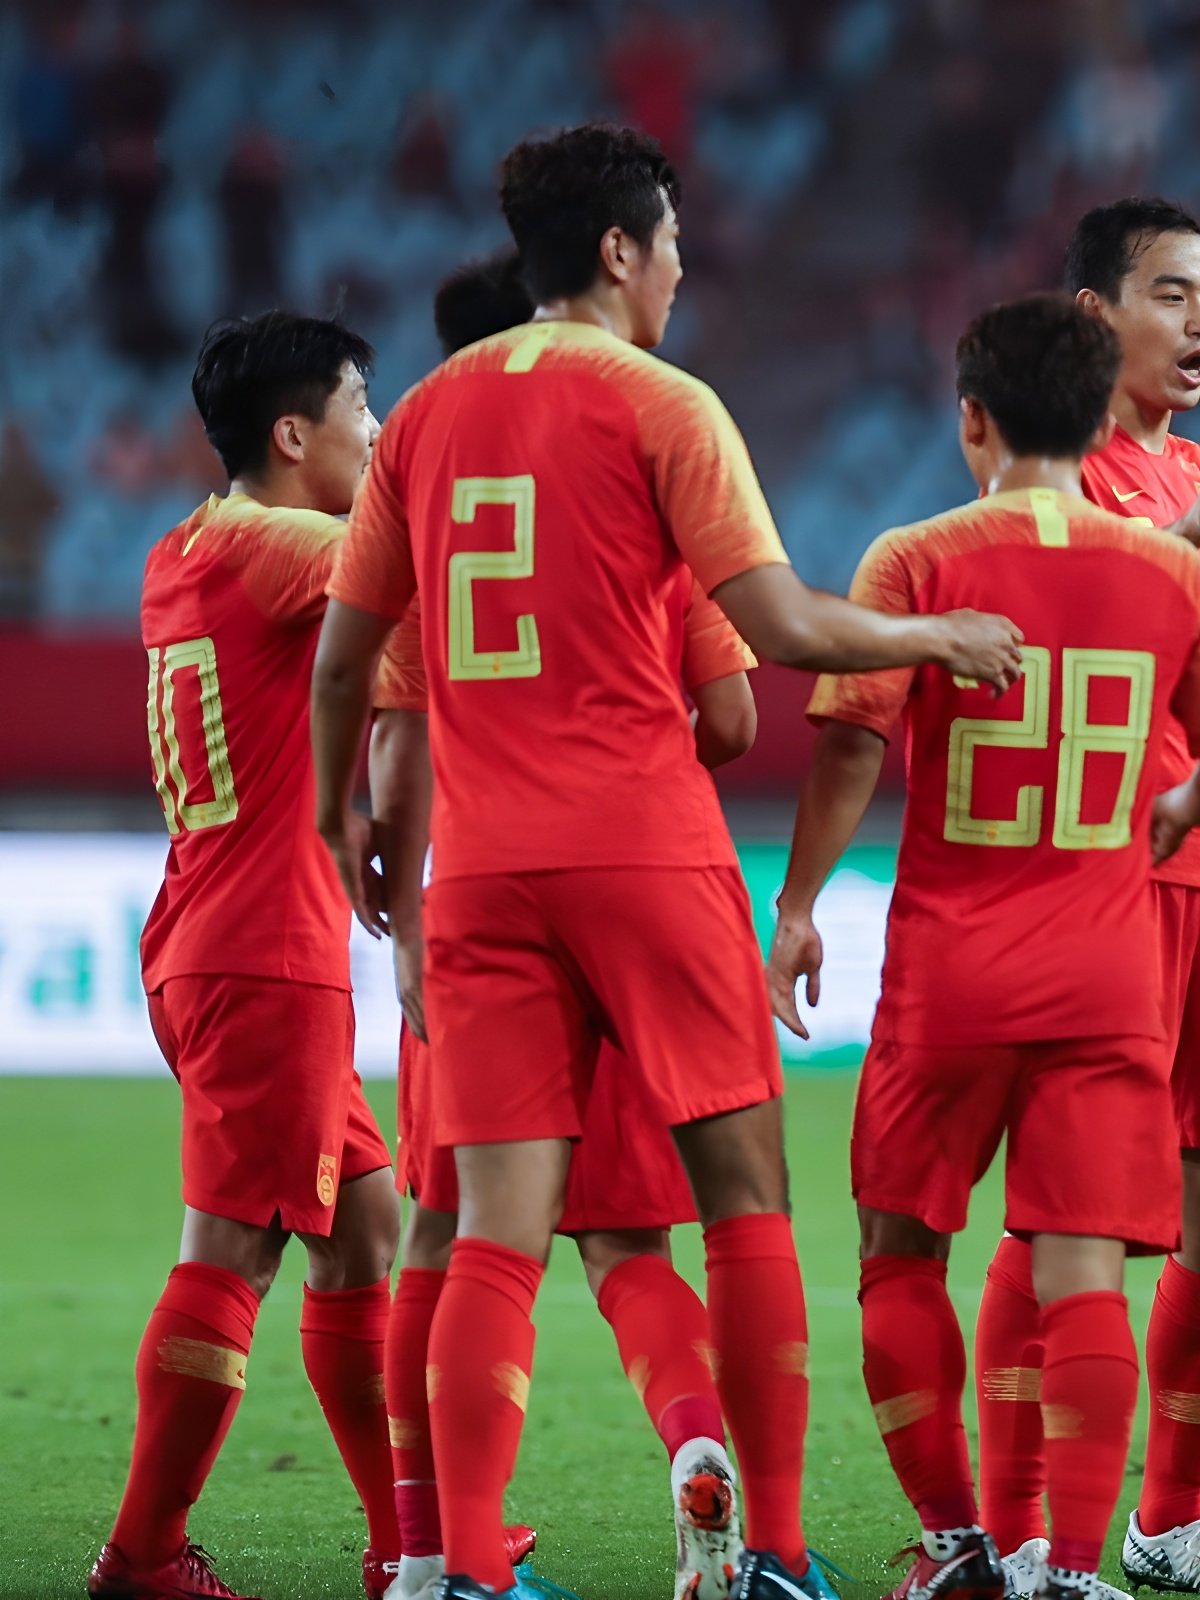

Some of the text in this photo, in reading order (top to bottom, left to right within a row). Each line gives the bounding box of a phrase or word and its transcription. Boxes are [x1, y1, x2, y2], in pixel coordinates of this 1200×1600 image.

[448, 474, 541, 681] 2
[147, 637, 239, 835] 10
[944, 645, 1155, 850] 28
